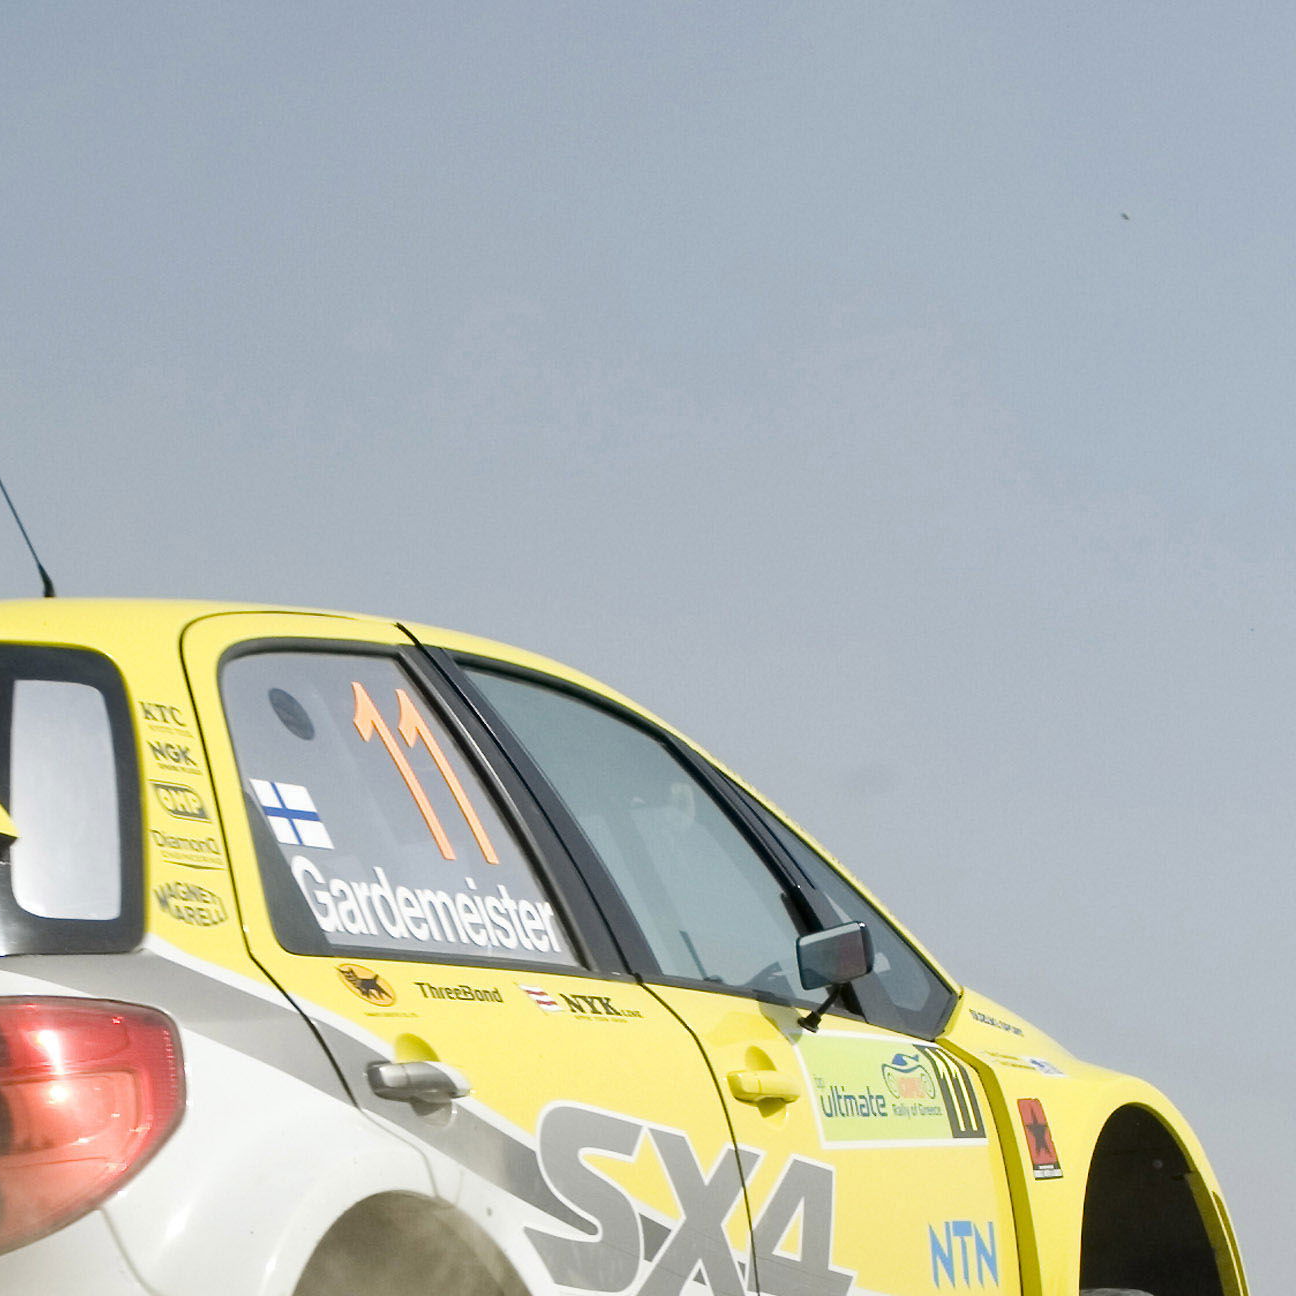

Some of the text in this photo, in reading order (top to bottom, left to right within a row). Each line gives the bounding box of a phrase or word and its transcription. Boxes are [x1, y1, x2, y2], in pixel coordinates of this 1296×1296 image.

[138, 701, 187, 728] KTC
[147, 740, 198, 768] NGK
[351, 681, 500, 865] 11
[290, 855, 562, 953] Gardemeister
[414, 982, 504, 1003] ThreeBond
[559, 993, 623, 1016] NYK
[928, 1220, 999, 1288] NTN
